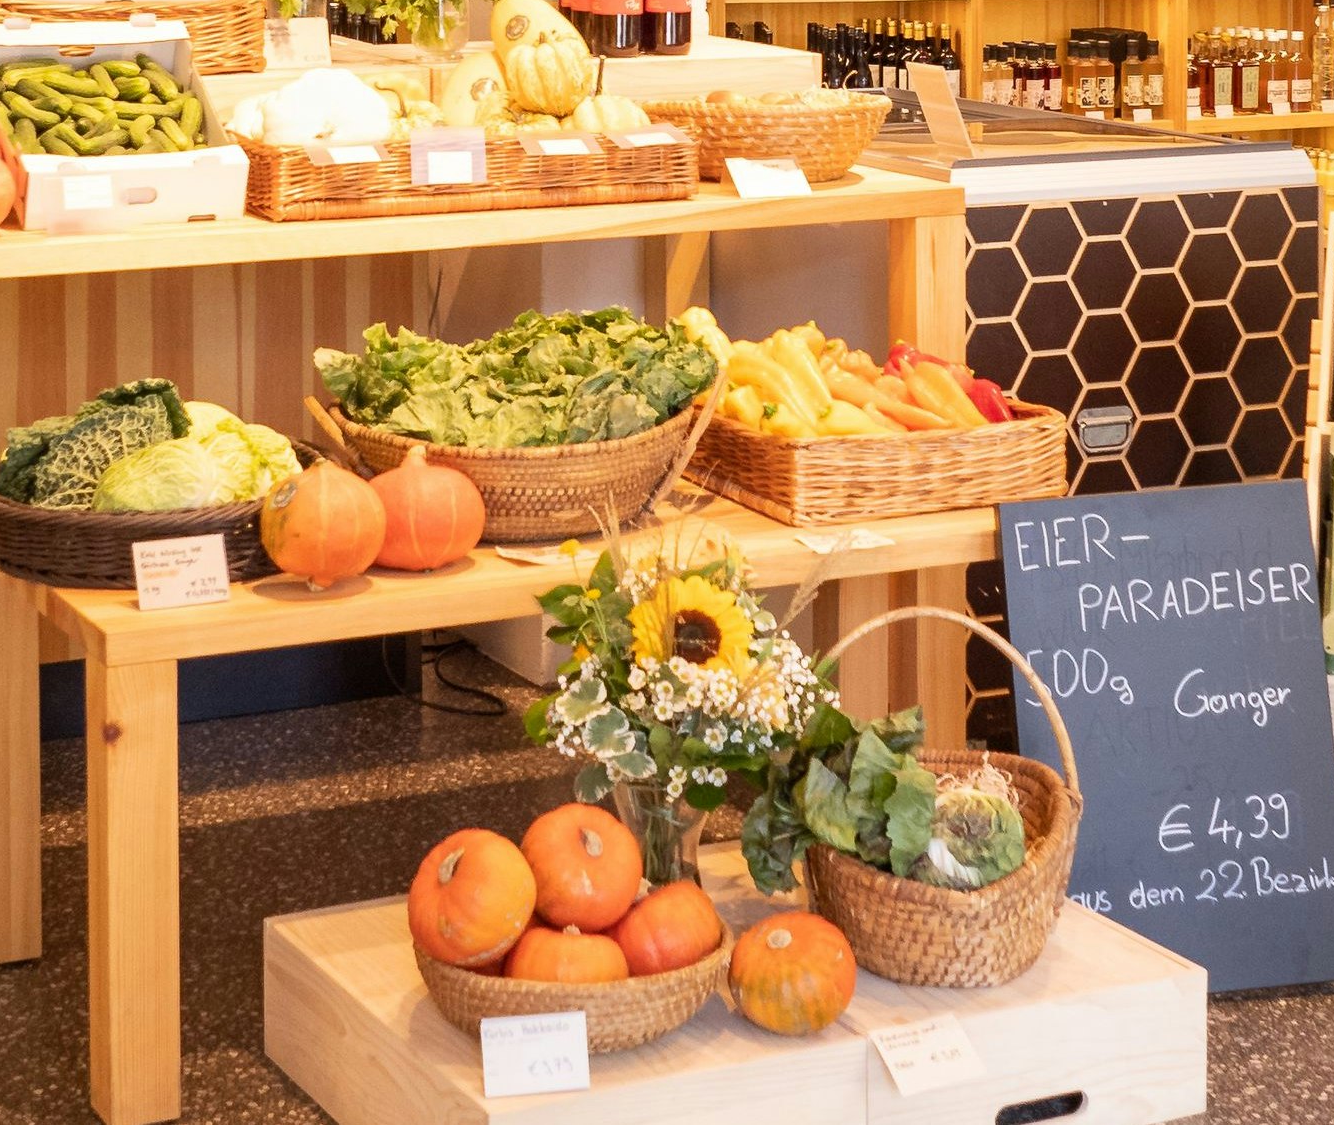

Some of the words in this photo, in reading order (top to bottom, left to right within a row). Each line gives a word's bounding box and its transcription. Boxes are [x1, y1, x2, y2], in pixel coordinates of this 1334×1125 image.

[1014, 513, 1150, 572] EIER-
[1078, 563, 1315, 632] PARADEISER
[1024, 646, 1135, 707] 500g
[1158, 803, 1195, 852] €
[1208, 793, 1289, 849] 4,39
[1128, 880, 1185, 909] dem
